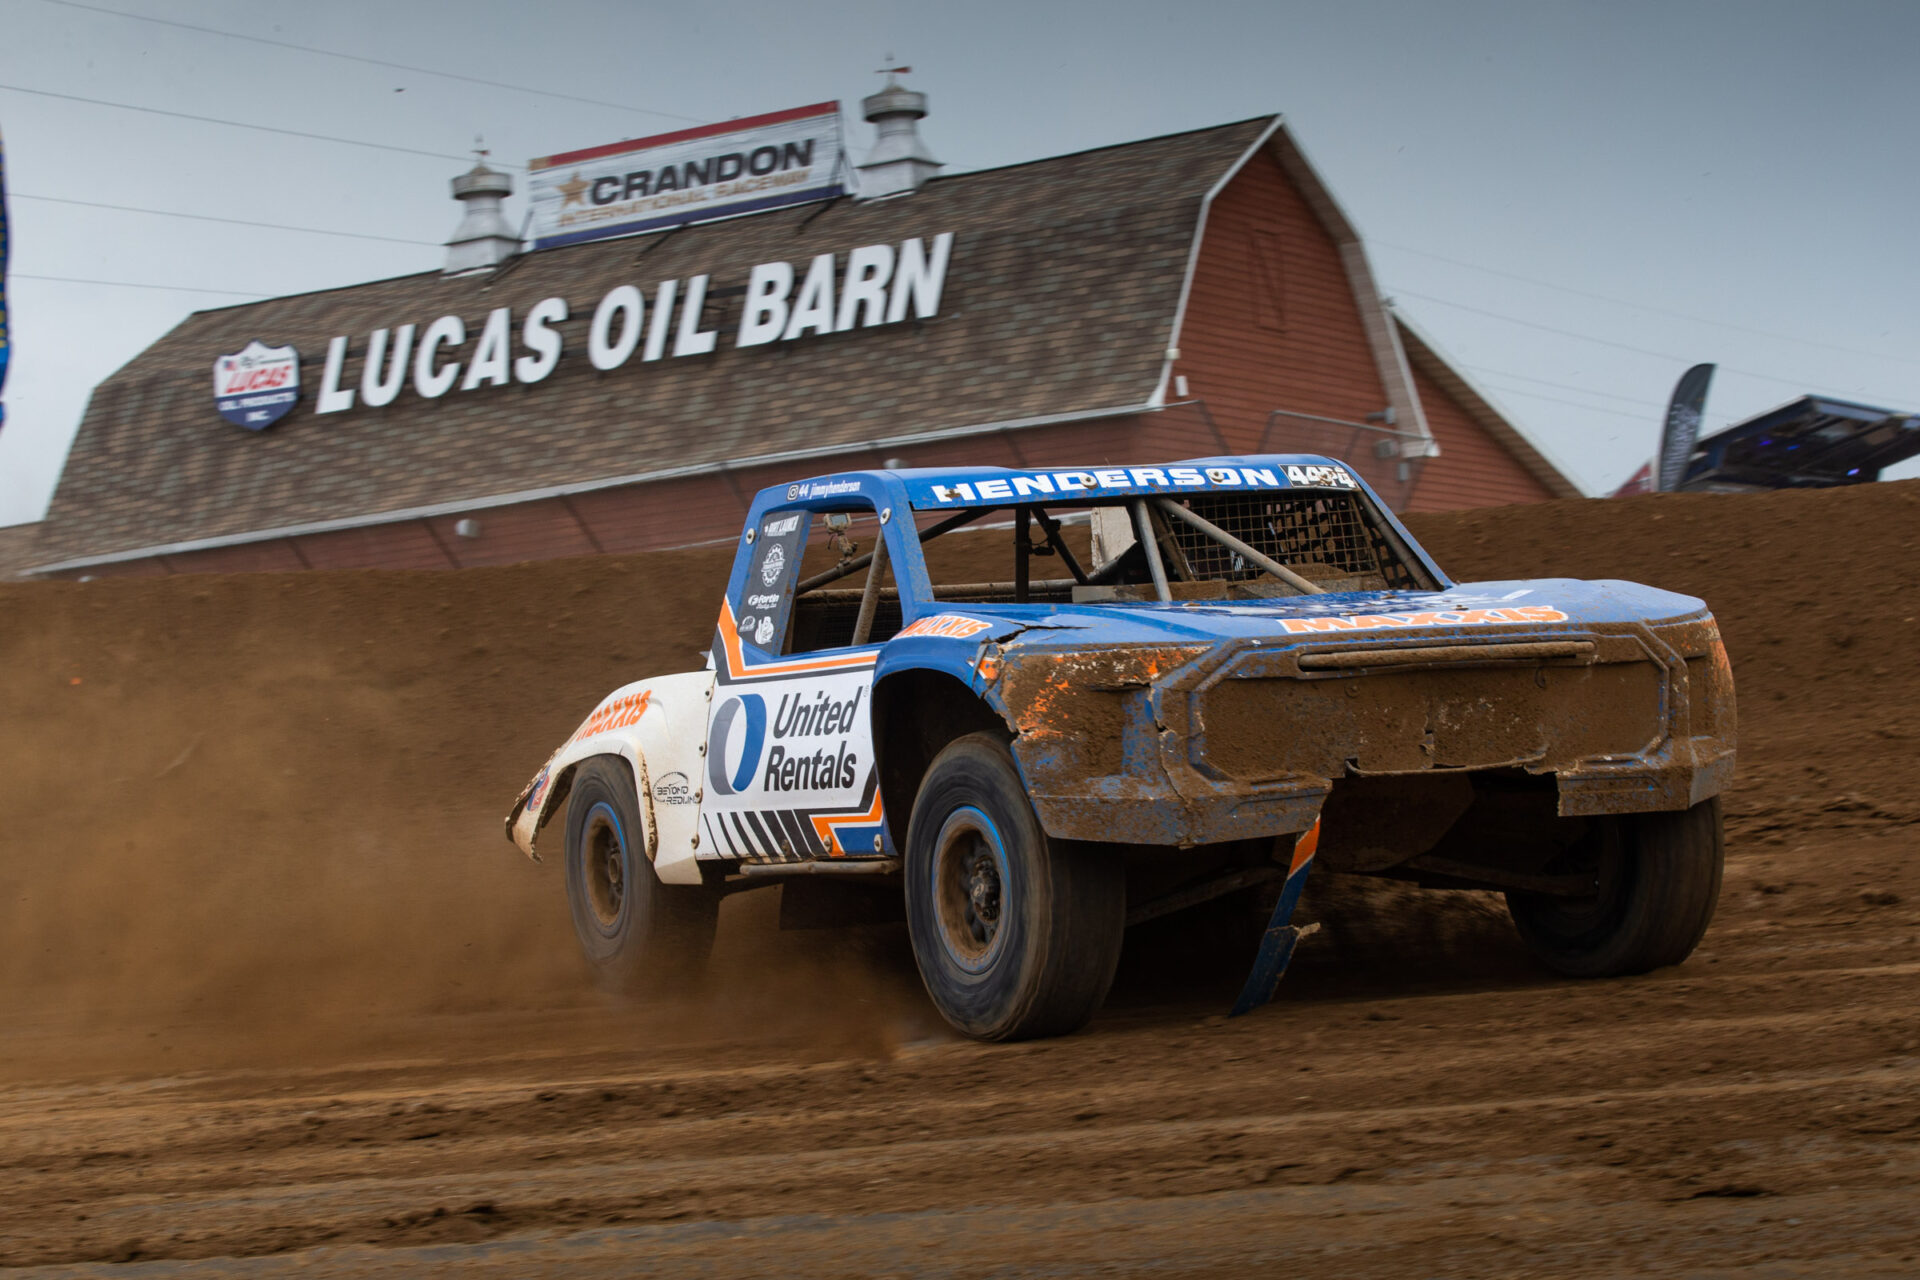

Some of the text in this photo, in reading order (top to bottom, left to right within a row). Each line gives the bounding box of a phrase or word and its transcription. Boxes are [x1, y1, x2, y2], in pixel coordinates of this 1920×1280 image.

[590, 138, 815, 206] CRANDON
[316, 232, 955, 414] LUCAS OIL BARN
[931, 467, 1279, 503] HENDERSON
[1279, 605, 1568, 633] MAXXIS
[576, 689, 652, 742] MAXXIS
[773, 685, 863, 739] United
[763, 740, 857, 792] Rentals
